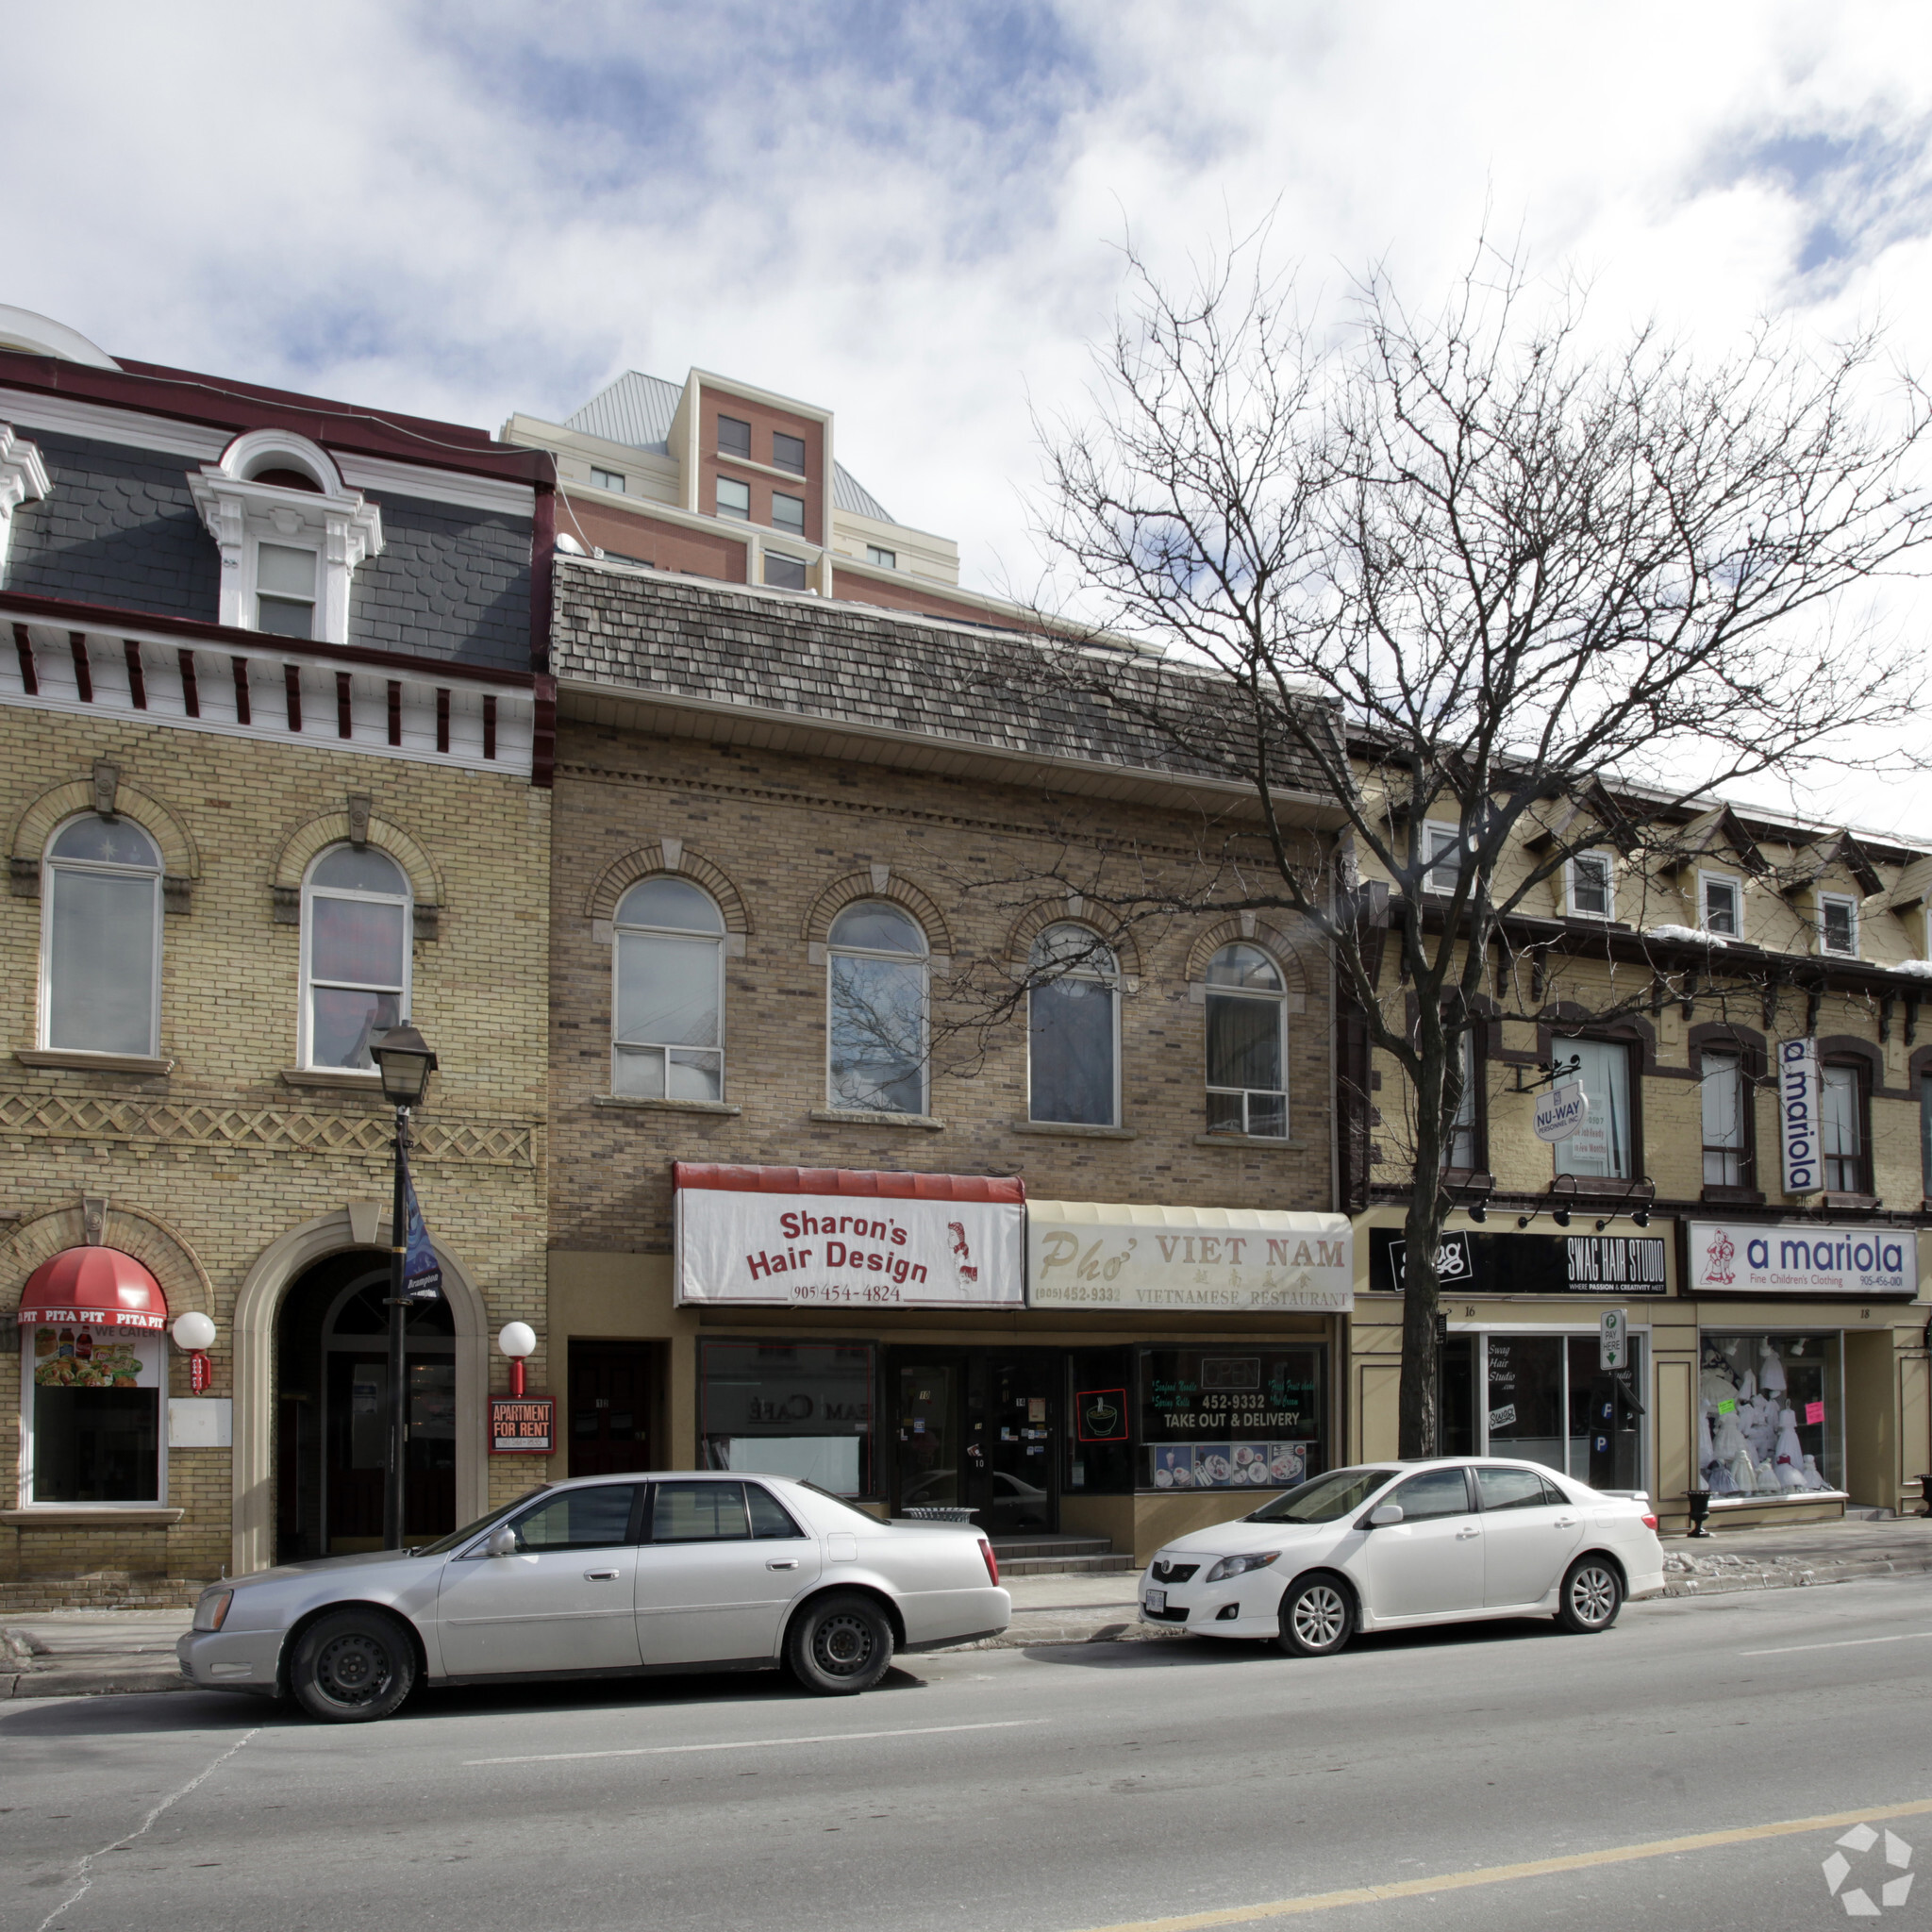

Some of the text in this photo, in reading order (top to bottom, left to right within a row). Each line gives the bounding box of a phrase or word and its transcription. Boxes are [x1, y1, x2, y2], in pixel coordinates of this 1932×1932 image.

[1537, 1100, 1579, 1127] NU-WAY
[1784, 1041, 1816, 1189] a mariola
[1538, 1115, 1578, 1134] PERSONNEL INC
[780, 1210, 908, 1245] Sharon's
[1155, 1235, 1345, 1268] VIET NAM
[1747, 1234, 1903, 1272] a mariola
[746, 1241, 928, 1284] Hair Design
[1568, 1238, 1664, 1282] SWAG HAIR STUDIO
[408, 1274, 439, 1289] Brampton
[1750, 1274, 1843, 1288] Fine Children's Clothing
[1136, 1290, 1348, 1306] VIETNAMESE RESTAURANT
[23, 1311, 38, 1321] PIT
[45, 1310, 106, 1323] PITA PIT
[1465, 1306, 1475, 1317] 16
[1860, 1309, 1870, 1319] 18
[116, 1313, 164, 1328] PITA PIT
[95, 1326, 157, 1338] WE CATER
[1606, 1330, 1617, 1340] PAY
[1489, 1344, 1510, 1357] Swag
[1604, 1340, 1621, 1351] HERE
[1489, 1358, 1509, 1368] Hair
[1205, 1362, 1257, 1385] OPEN
[1489, 1372, 1515, 1381] Studio
[1202, 1394, 1265, 1409] 452-9332
[493, 1404, 550, 1421] APARTMENT
[1164, 1412, 1300, 1428] TAKE OUT & DELIVERY
[494, 1423, 549, 1436] FOR RENT
